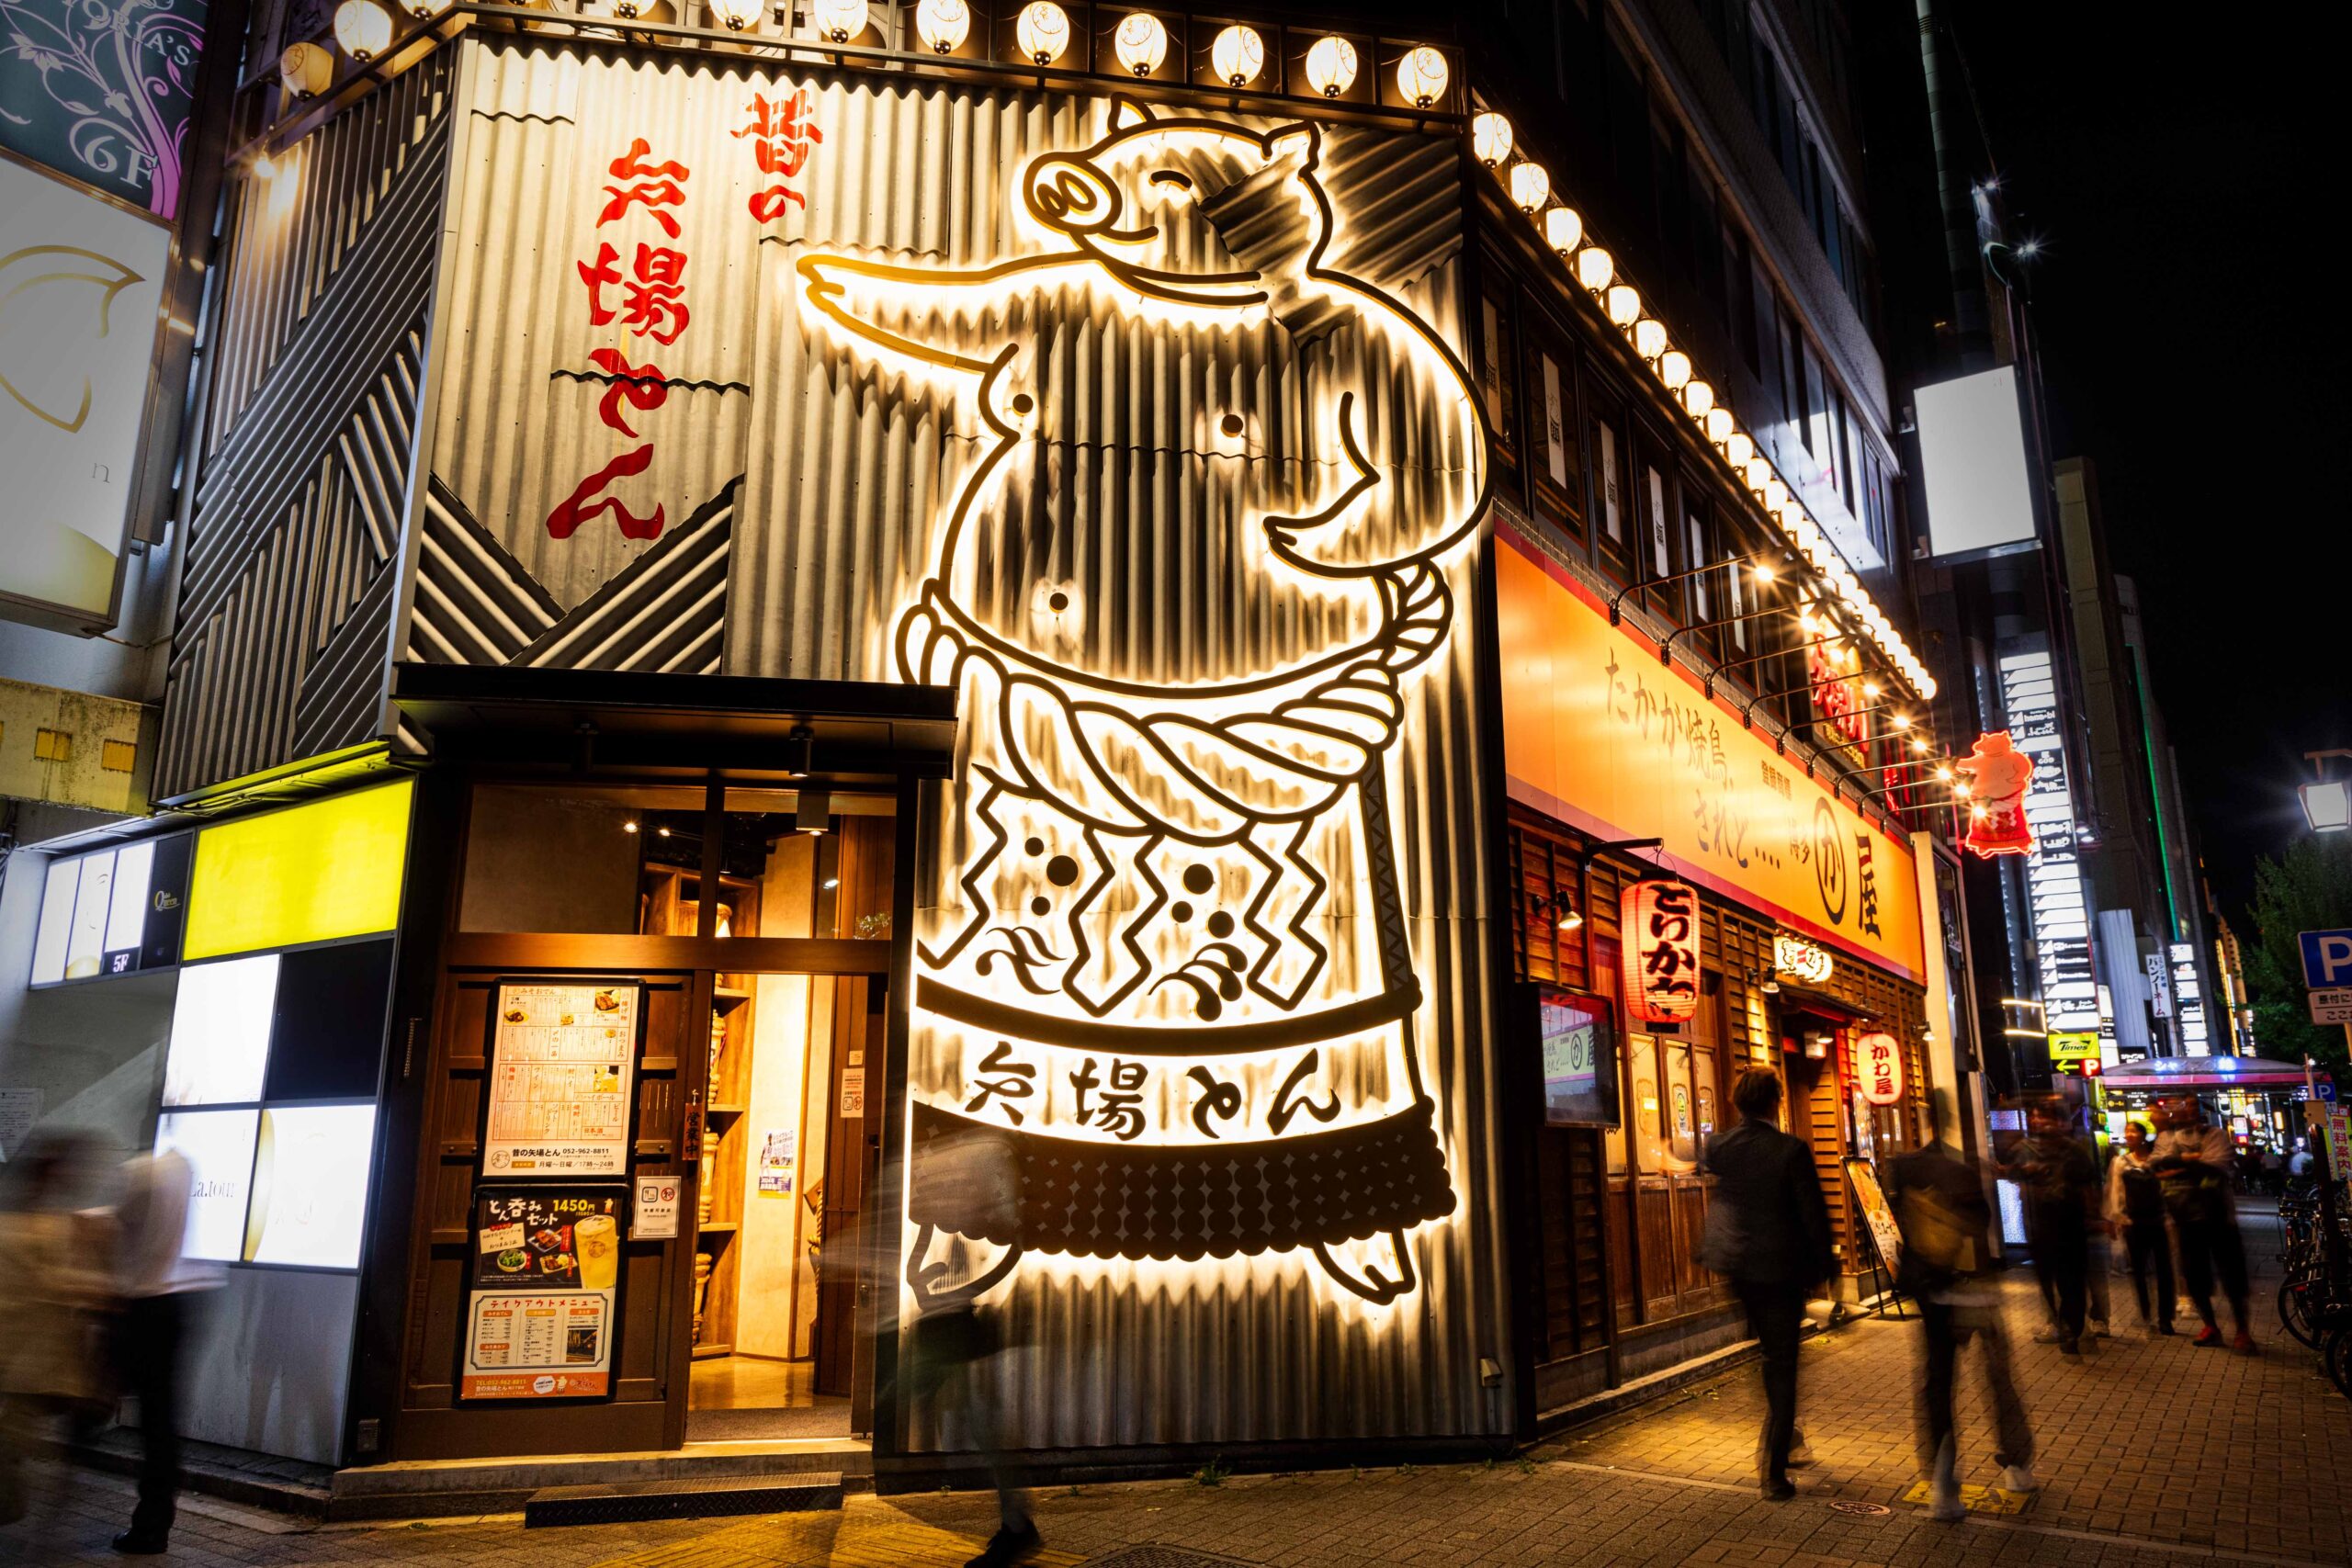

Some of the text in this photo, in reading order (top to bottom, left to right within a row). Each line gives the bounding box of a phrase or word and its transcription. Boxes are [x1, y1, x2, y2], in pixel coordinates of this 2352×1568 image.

[62, 0, 191, 66] ORIA'S
[84, 135, 158, 189] 6F
[729, 88, 823, 224] 昔の
[546, 137, 691, 540] 矢場とん
[112, 953, 130, 973] 5F
[2318, 936, 2352, 982] P
[2325, 1010, 2352, 1021] ここ
[2058, 1039, 2092, 1053] Times
[1870, 1043, 1894, 1096] かわ屋
[2084, 1059, 2099, 1076] P
[965, 1040, 1340, 1141] 矢場とん
[2317, 1084, 2332, 1100] P
[685, 1111, 700, 1156] 営業中
[512, 1148, 560, 1157] 昔の矢場とん
[553, 1199, 595, 1212] 1450円
[526, 1213, 559, 1226] セット
[491, 1299, 600, 1308] テイクアウトメニュー
